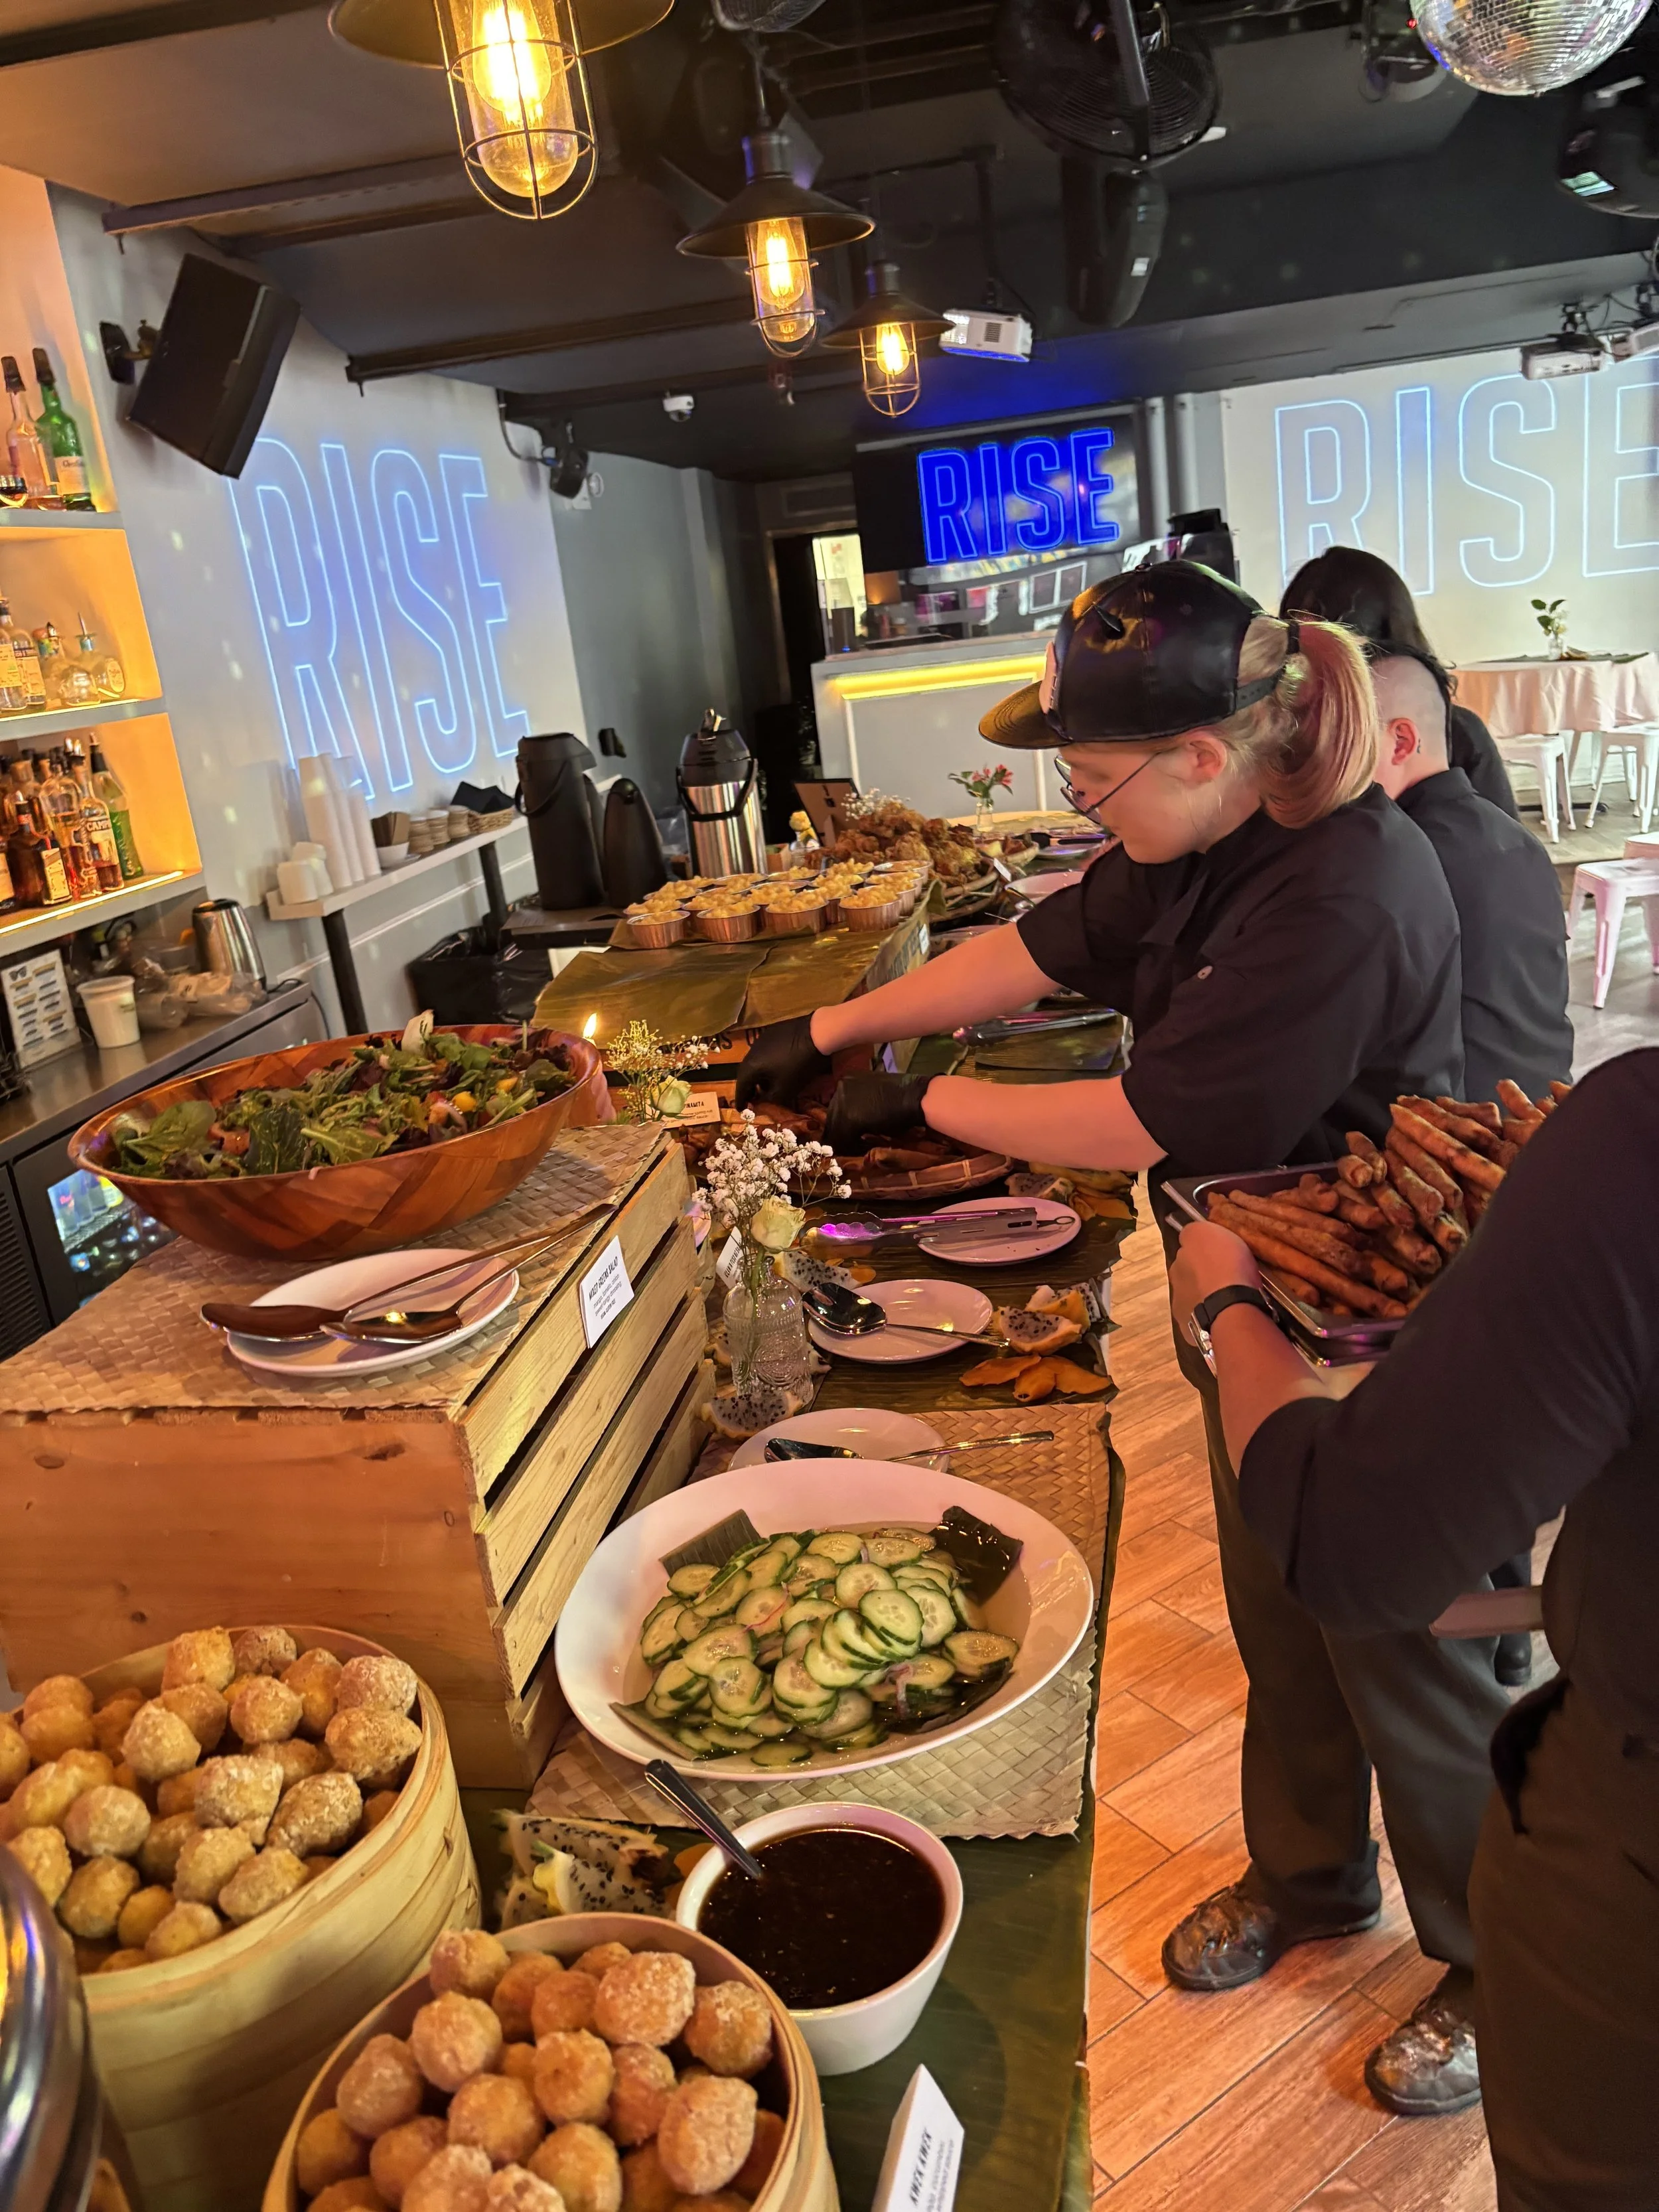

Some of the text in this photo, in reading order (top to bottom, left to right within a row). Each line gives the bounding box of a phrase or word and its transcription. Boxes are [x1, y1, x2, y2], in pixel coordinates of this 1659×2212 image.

[918, 427, 1119, 564] RISE
[1274, 356, 1659, 596] RISE
[226, 438, 531, 800] RISE
[589, 1256, 618, 1301] MIXED GREENS SALAD
